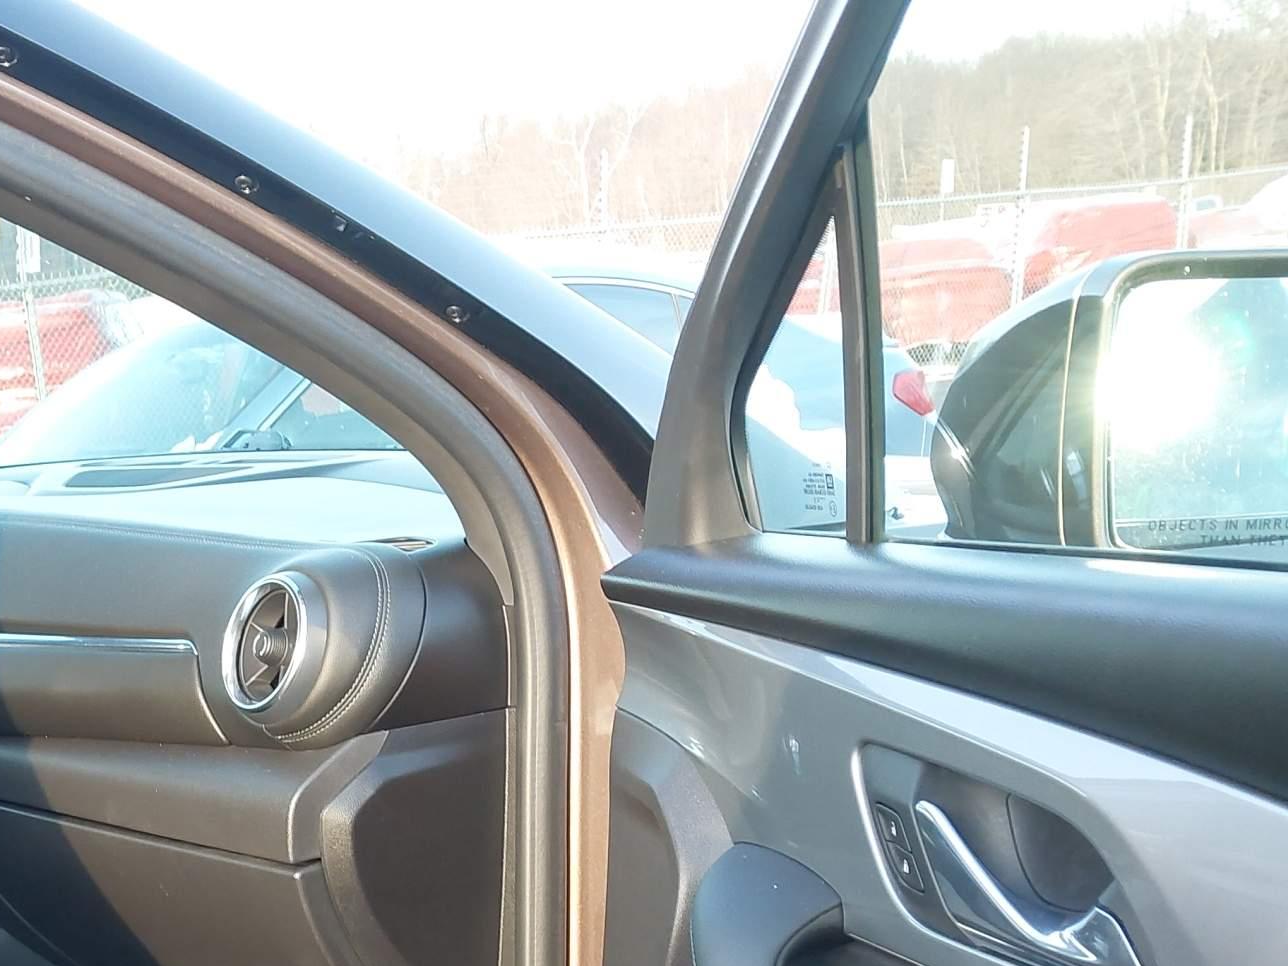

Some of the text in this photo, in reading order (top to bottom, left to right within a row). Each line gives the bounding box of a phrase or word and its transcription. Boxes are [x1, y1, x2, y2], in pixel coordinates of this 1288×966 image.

[1147, 519, 1218, 531] OBJECTS
[1225, 519, 1240, 530] IN
[1200, 534, 1241, 546] THAN
